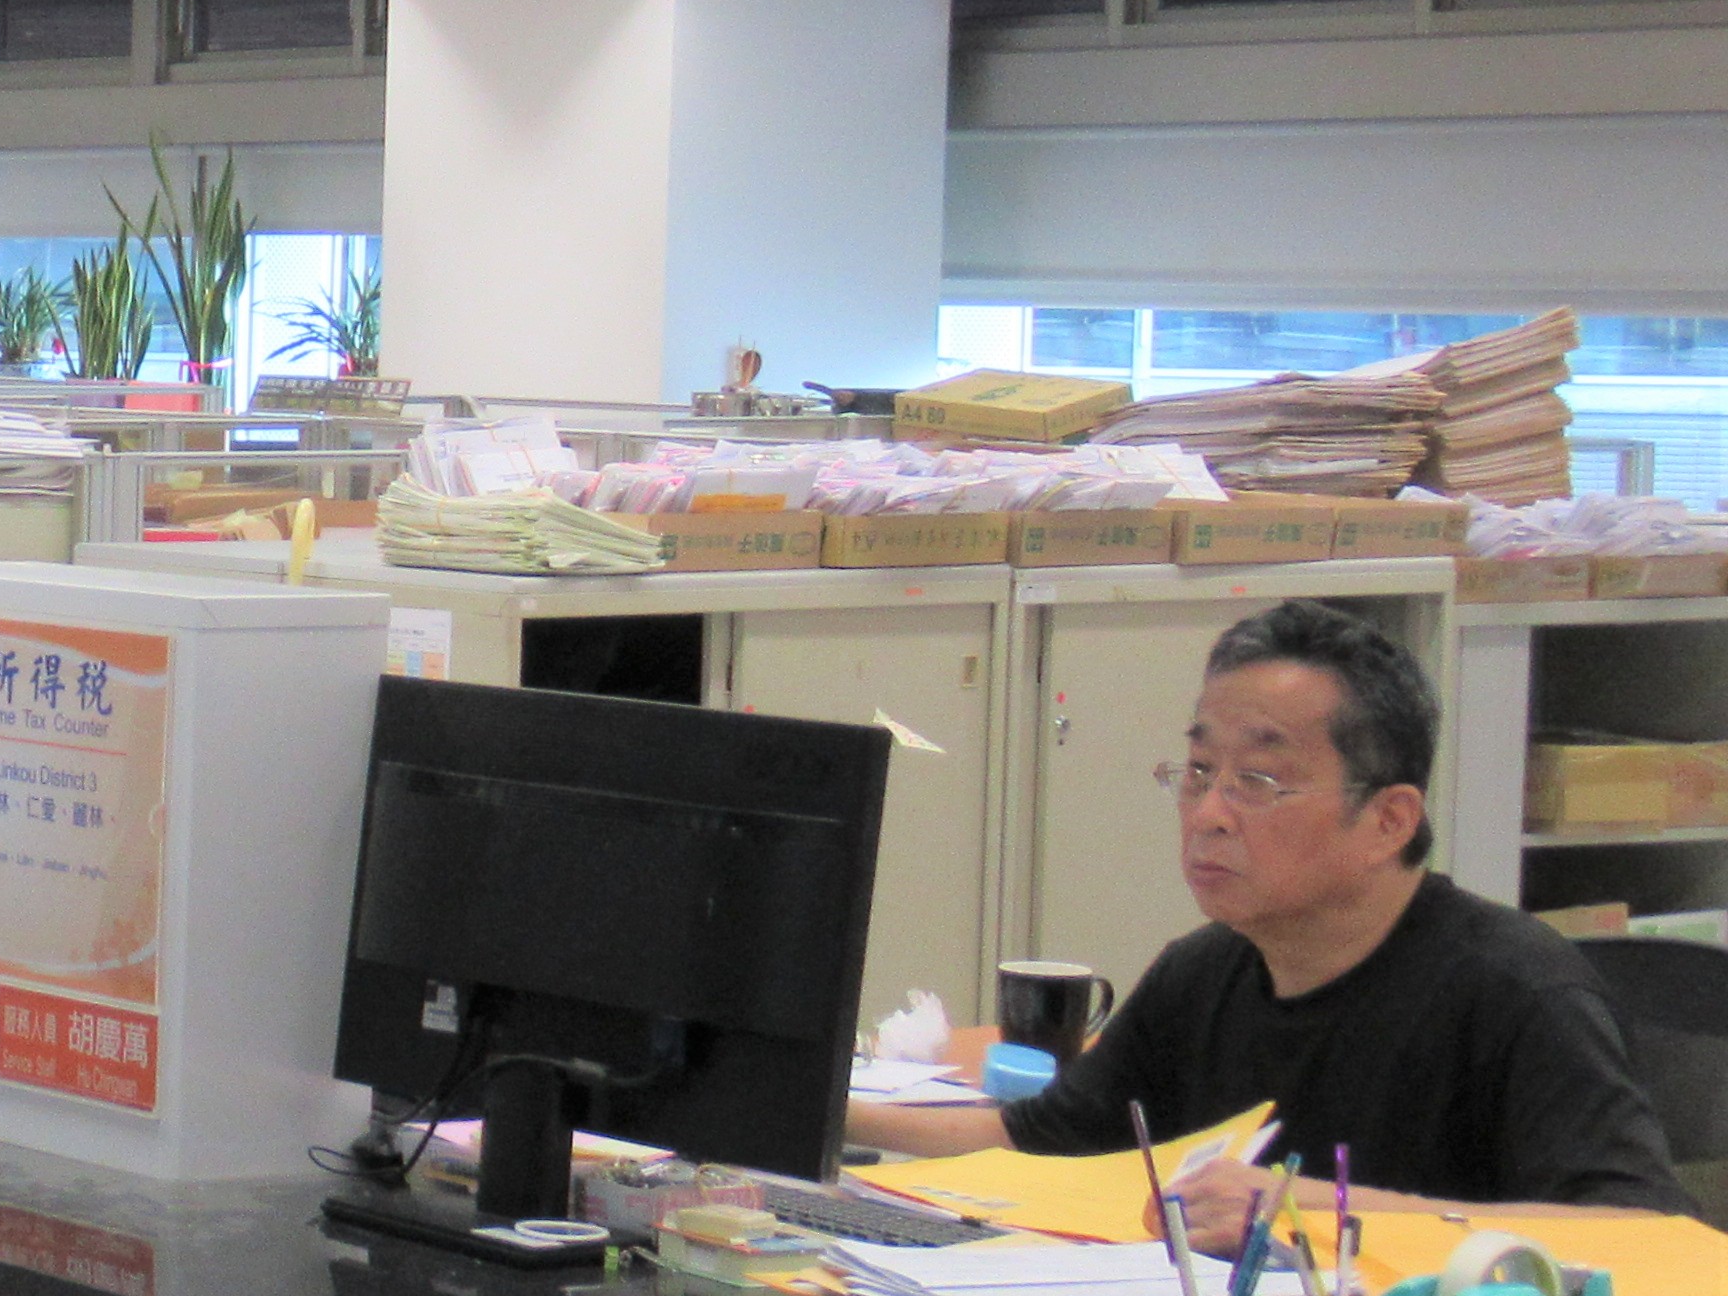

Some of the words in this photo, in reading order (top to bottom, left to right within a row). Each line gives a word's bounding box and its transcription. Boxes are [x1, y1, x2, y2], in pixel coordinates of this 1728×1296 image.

[23, 709, 47, 729] Tax
[53, 714, 110, 737] Counter
[40, 765, 85, 791] District
[88, 771, 99, 792] 3
